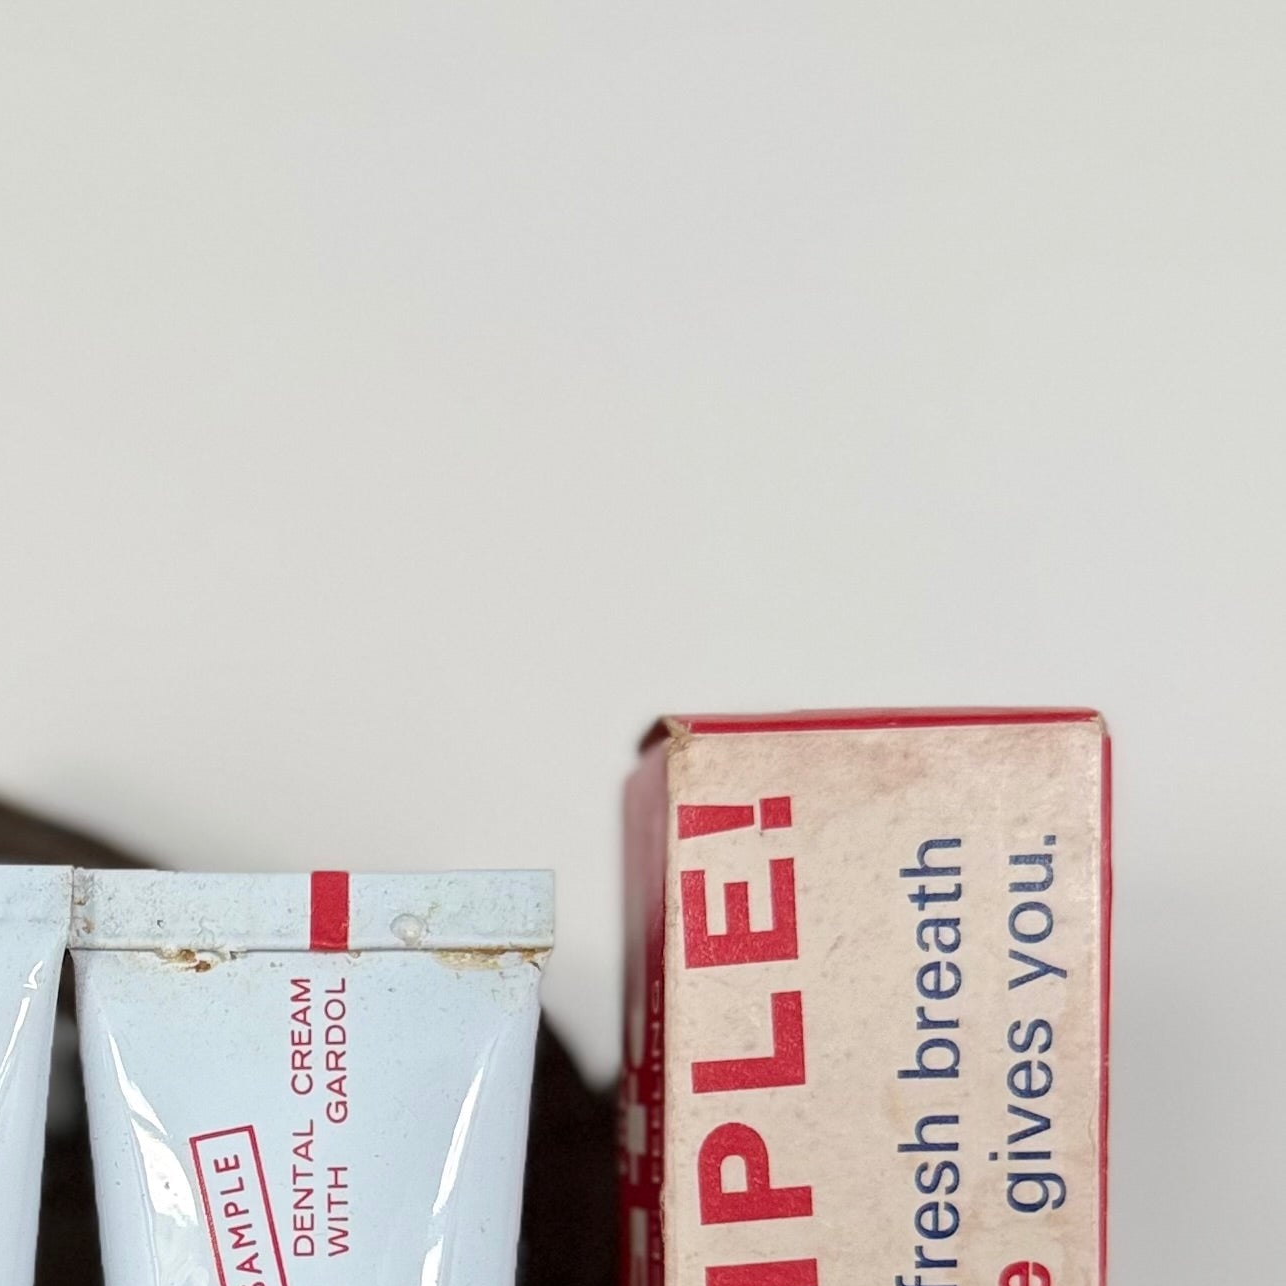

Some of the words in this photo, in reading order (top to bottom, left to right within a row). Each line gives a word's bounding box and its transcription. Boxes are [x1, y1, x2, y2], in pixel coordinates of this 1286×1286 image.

[898, 837, 962, 1079] breath
[1004, 834, 1067, 990] you.
[290, 978, 312, 1095] CREAM
[324, 978, 348, 1124] GARDOL
[292, 1119, 314, 1257] DENTAL
[989, 1019, 1067, 1214] gives
[326, 1166, 349, 1257] WITH
